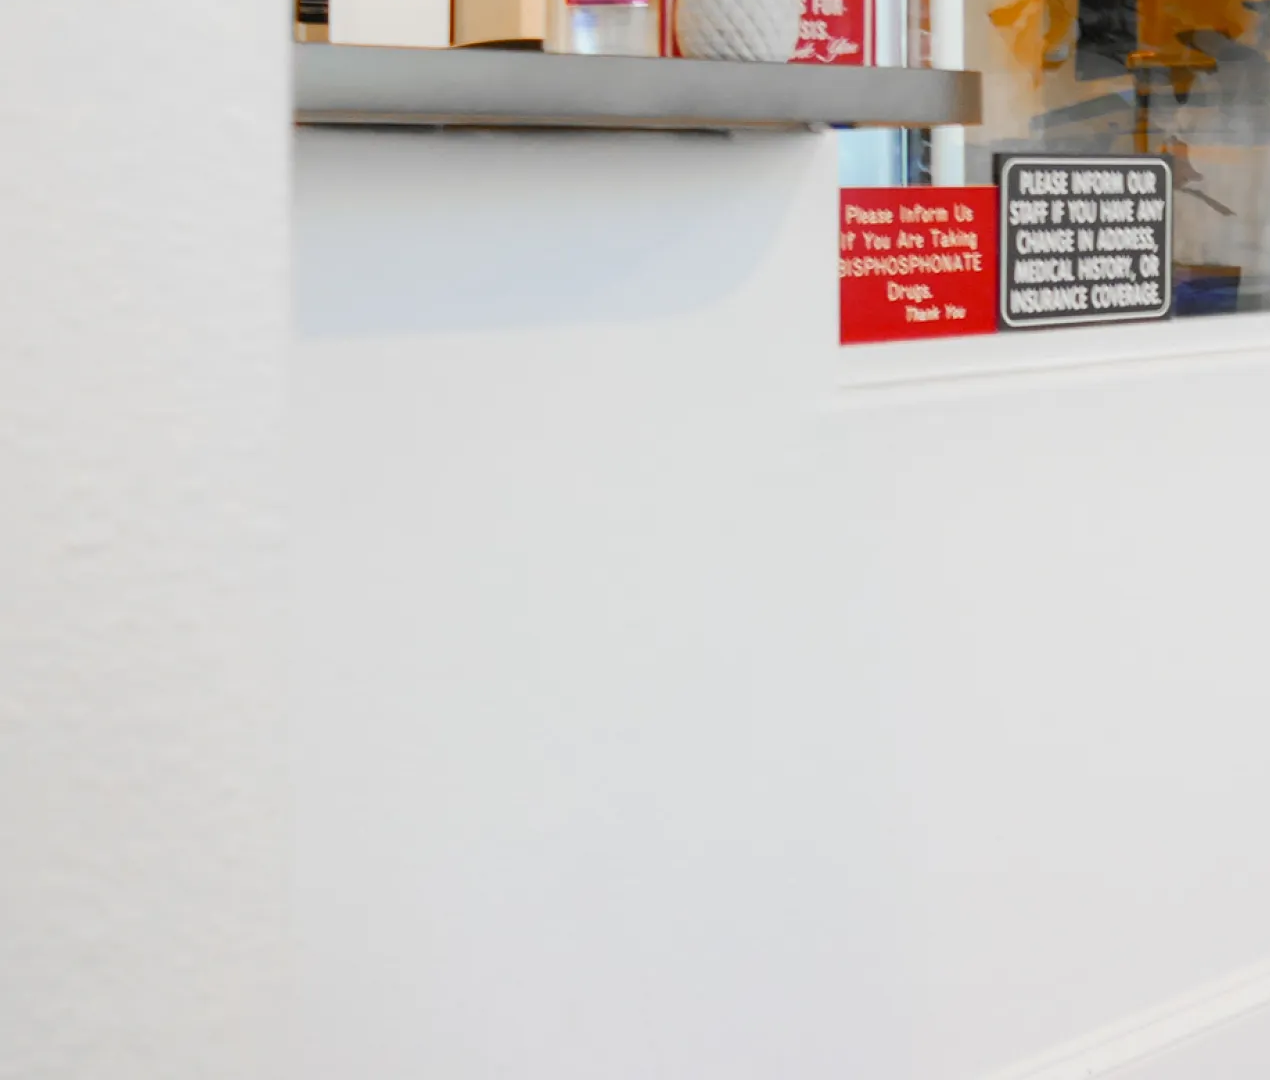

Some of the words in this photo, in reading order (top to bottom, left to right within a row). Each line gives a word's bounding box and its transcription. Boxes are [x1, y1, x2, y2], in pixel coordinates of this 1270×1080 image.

[1019, 170, 1068, 195] PLEASE
[1071, 170, 1125, 194] INFORM
[1127, 170, 1157, 195] OUR
[845, 204, 894, 224] Please
[900, 203, 949, 223] Inform
[953, 202, 974, 222] Us
[1009, 199, 1049, 226] STAFF
[1051, 199, 1065, 224] IF
[1067, 199, 1098, 224] YOU
[1100, 198, 1134, 223] HAVE
[1136, 197, 1165, 222] ANY
[840, 231, 856, 251] If
[862, 231, 891, 251] You
[897, 229, 924, 249] Are
[929, 228, 978, 251] Taking
[1016, 228, 1075, 255] CHANGE
[1077, 228, 1094, 252] IN
[1097, 225, 1158, 253] ADDRESS,
[839, 251, 983, 278] BISPHOSPHONATE
[1014, 257, 1075, 284] MEDICAL
[1078, 255, 1137, 282] HISTORY,
[1139, 253, 1160, 278] OR
[887, 281, 934, 303] Drugs.
[1010, 285, 1089, 314] INSURANCE
[1091, 281, 1162, 310] COVERAGE.
[905, 305, 941, 323] Thank
[945, 303, 967, 320] You
